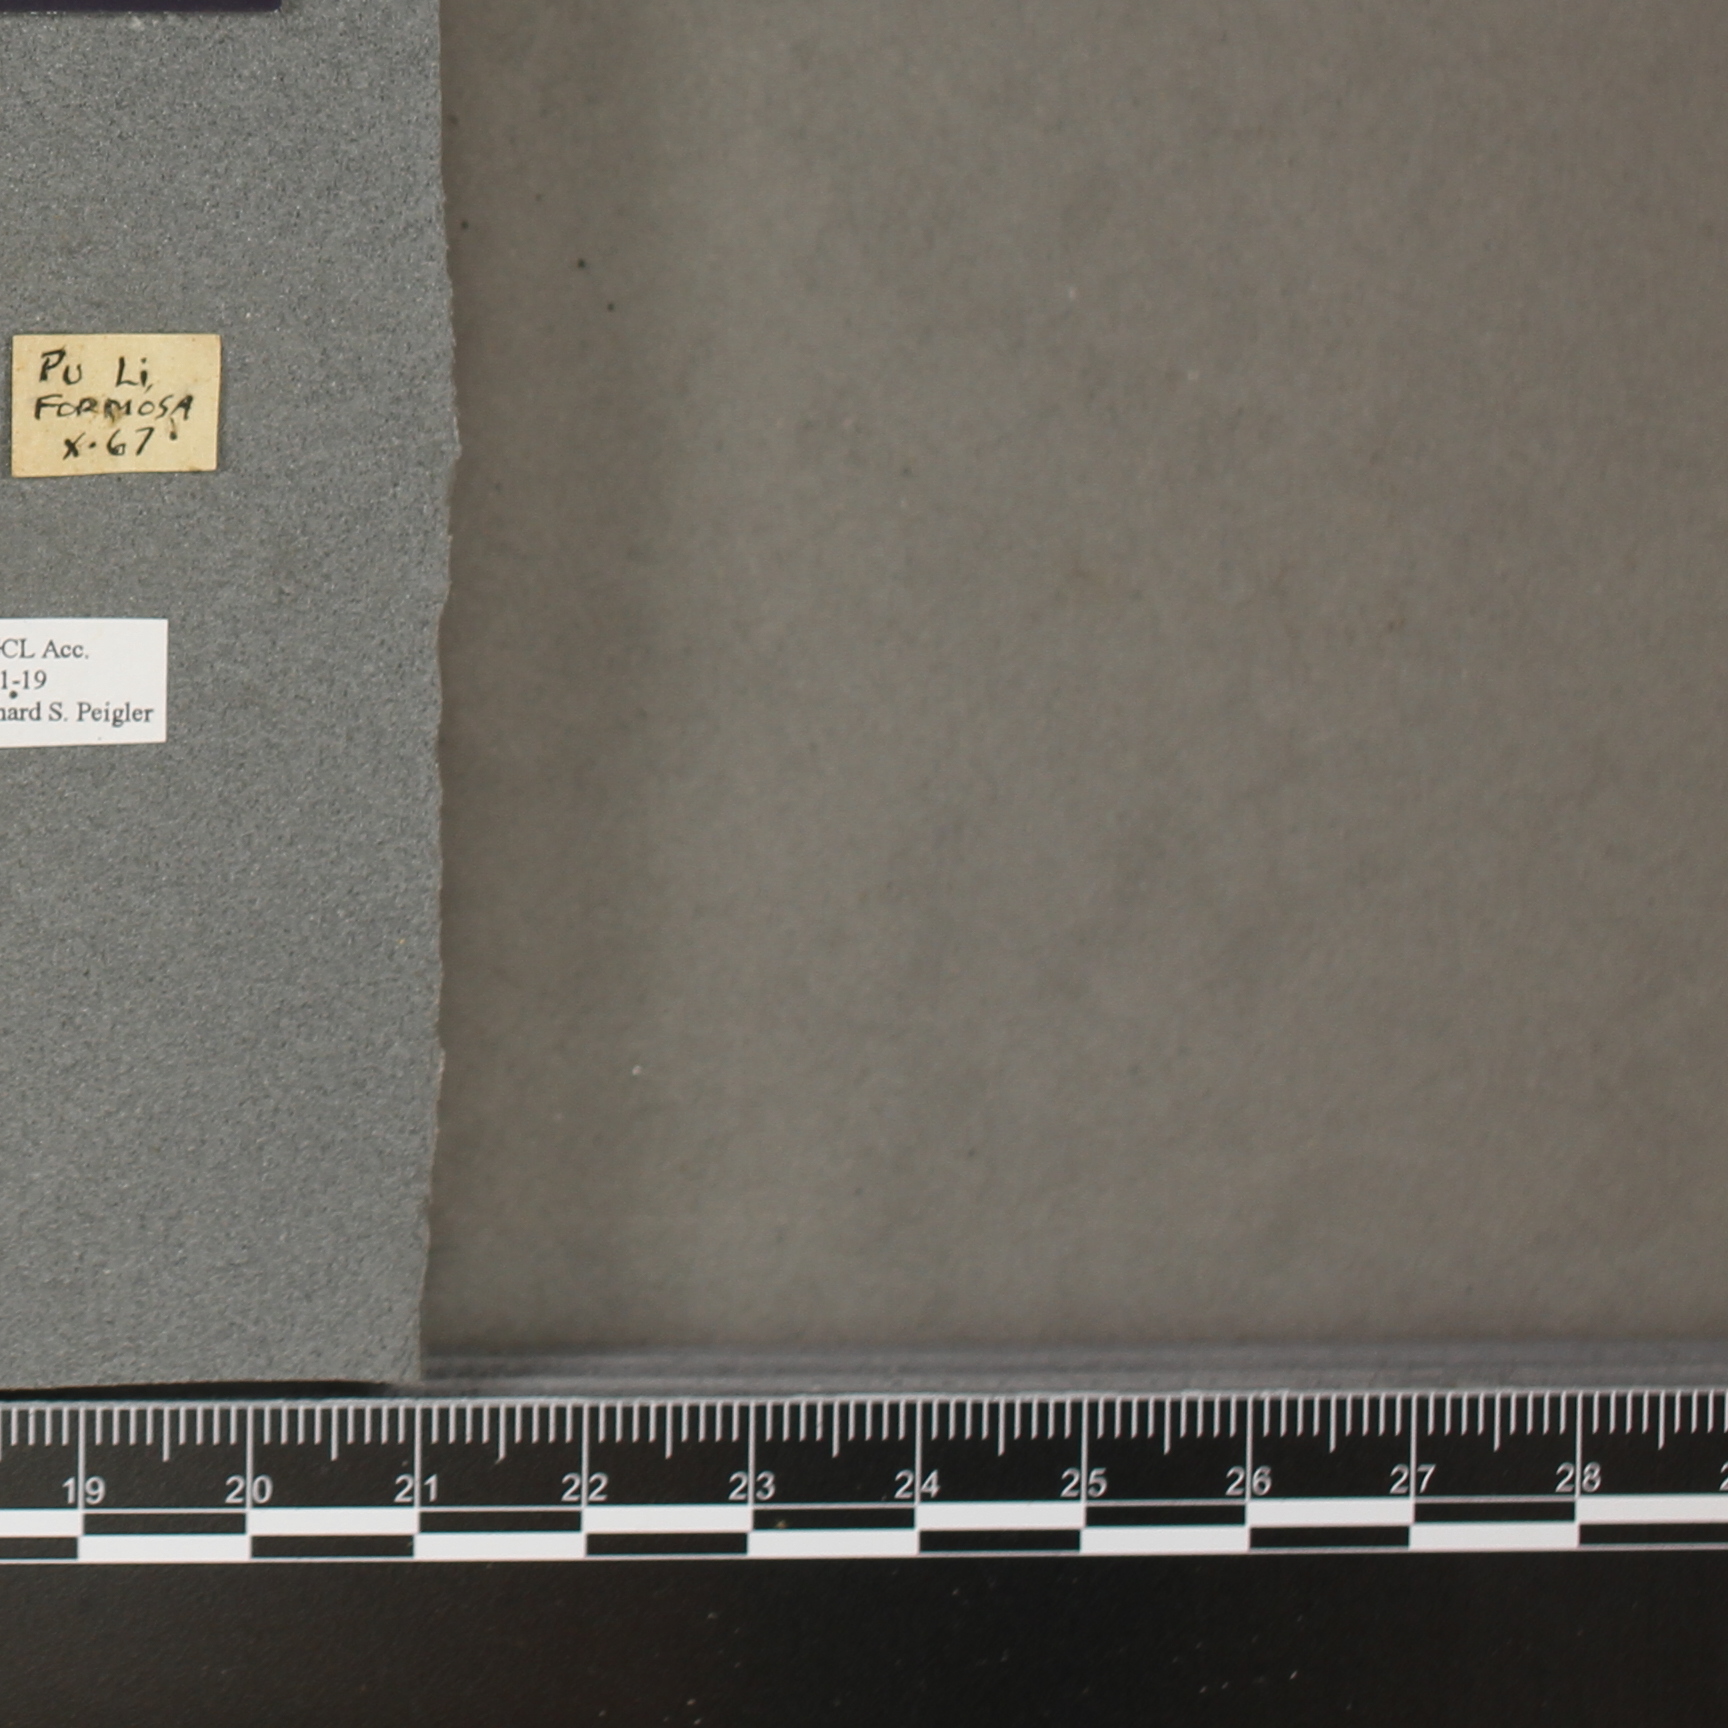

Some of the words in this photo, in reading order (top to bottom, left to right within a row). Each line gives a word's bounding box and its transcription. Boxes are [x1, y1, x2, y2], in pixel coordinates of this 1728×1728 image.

[41, 639, 90, 660] Acc.
[48, 701, 68, 722] S.
[77, 701, 155, 728] Peigler
[63, 1477, 106, 1504] 19
[226, 1476, 272, 1503] 20
[394, 1475, 436, 1502] 21
[562, 1474, 607, 1501] 22
[729, 1472, 774, 1500] 23
[895, 1470, 940, 1498] 24
[1062, 1469, 1106, 1497] 25
[1226, 1467, 1271, 1495] 26
[1391, 1465, 1436, 1493] 27
[1556, 1463, 1601, 1492] 28
